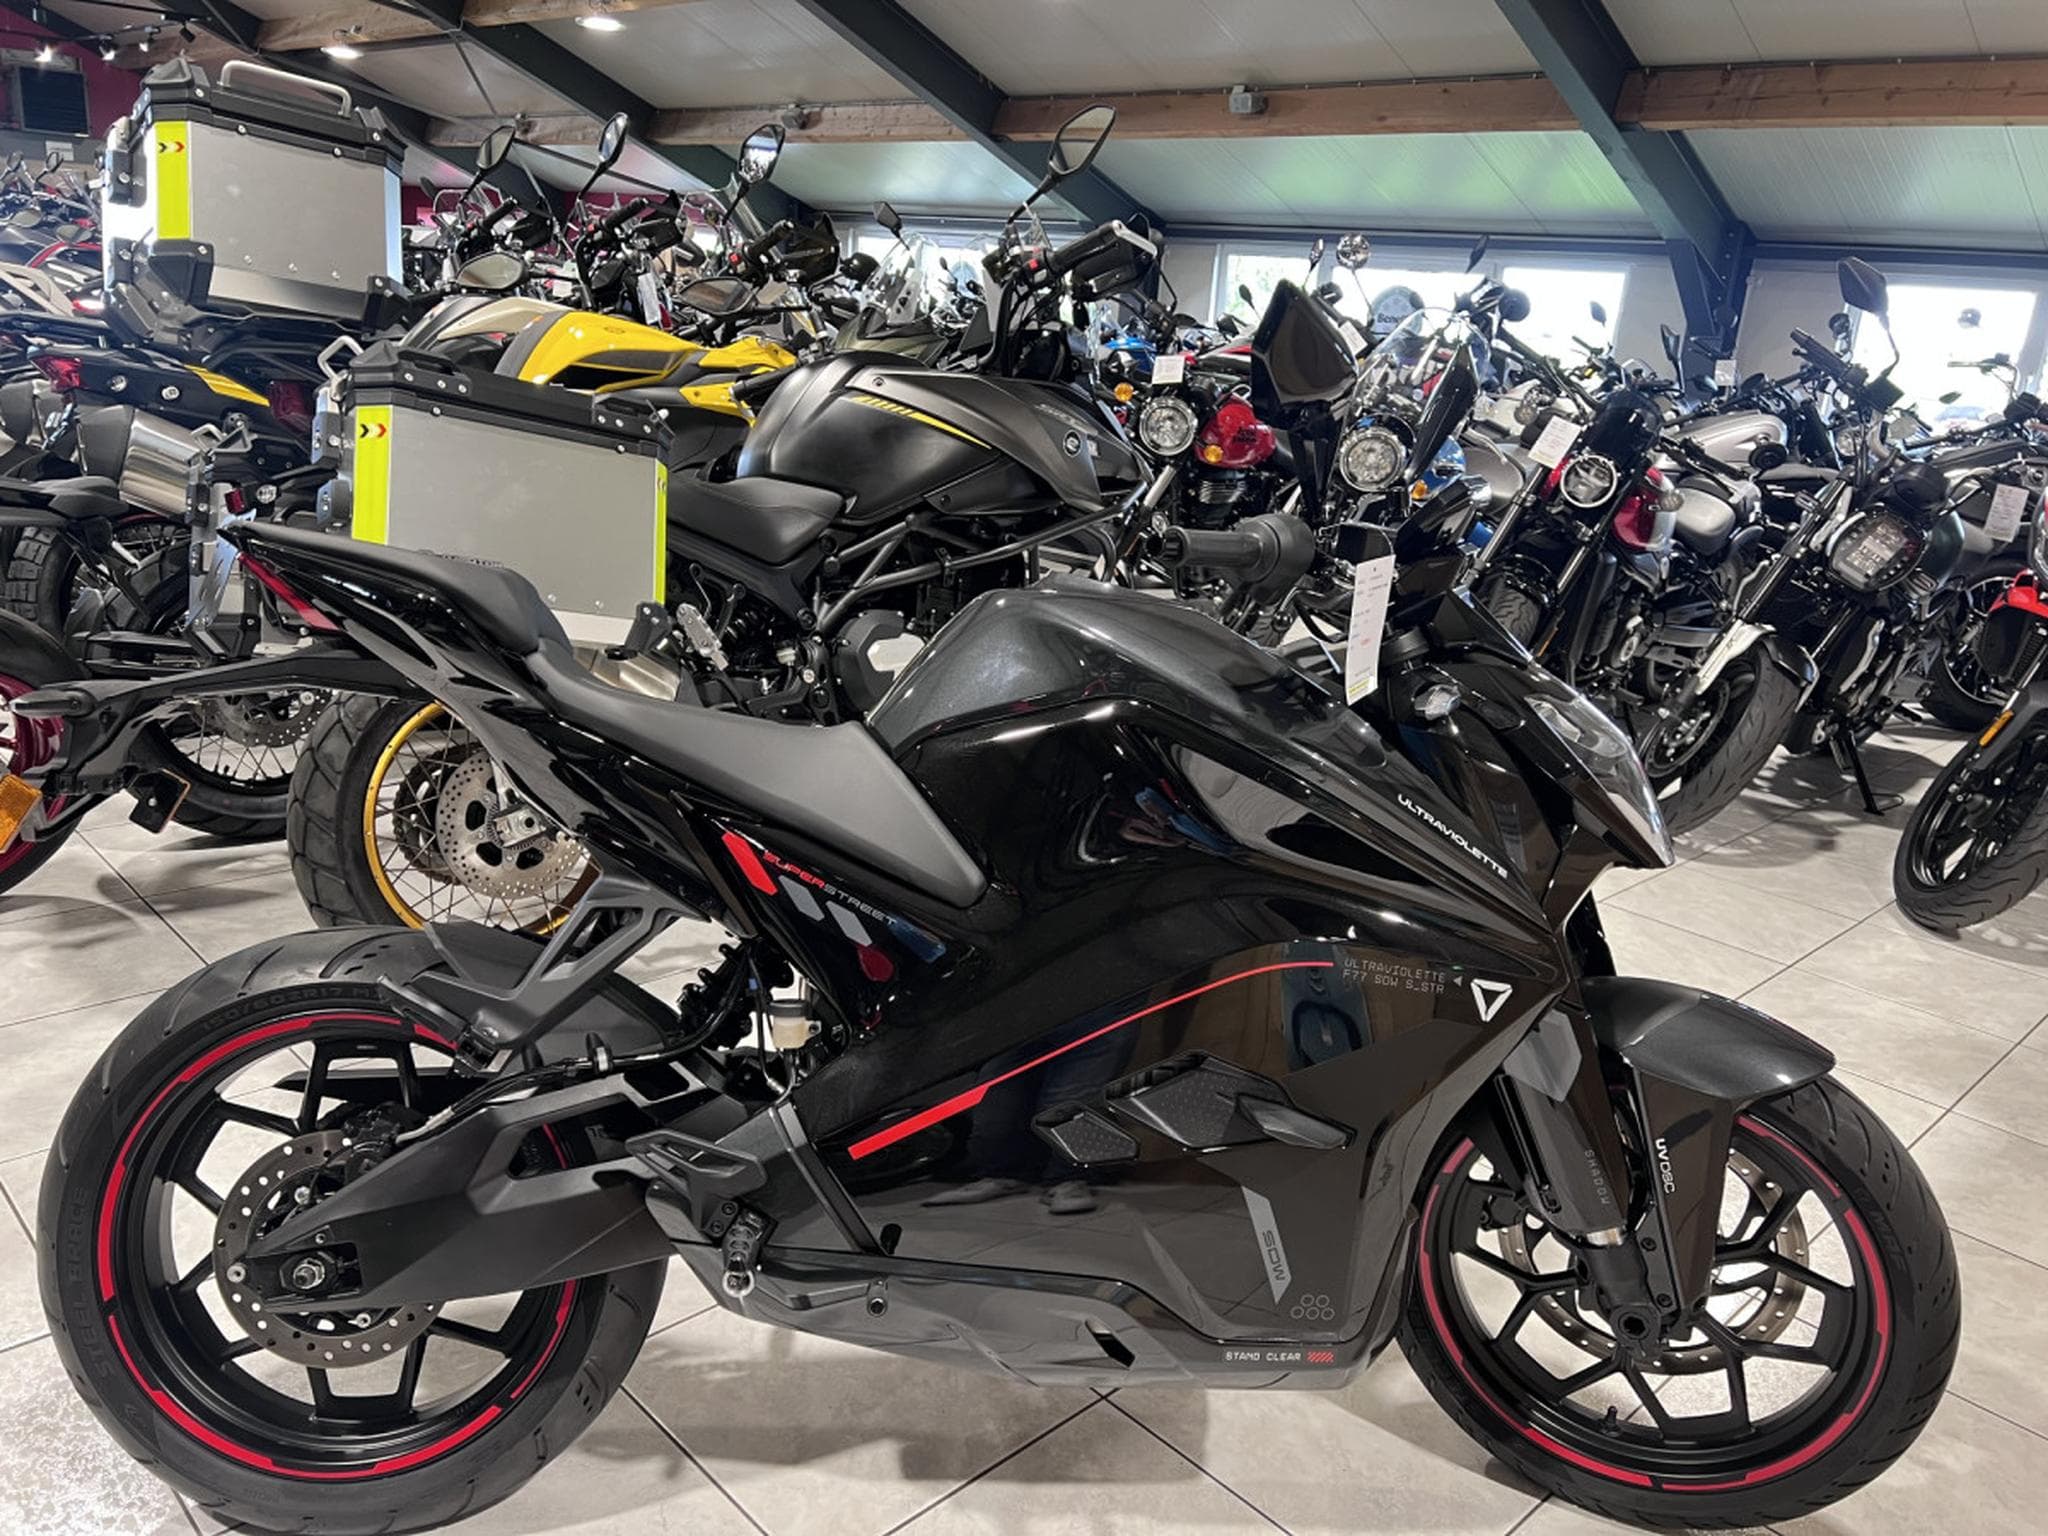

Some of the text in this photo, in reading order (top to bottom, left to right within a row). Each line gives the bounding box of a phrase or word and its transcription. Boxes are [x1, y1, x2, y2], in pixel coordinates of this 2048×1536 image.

[1397, 793, 1509, 880] ULTRAVIOLETTE
[762, 850, 898, 927] SUPERSTREET
[1342, 969, 1368, 982] F77
[1344, 958, 1446, 983] ULTRAVIOLETTE
[1584, 1148, 1611, 1205] SHADOW
[1225, 1351, 1302, 1362] STAND CLEAR
